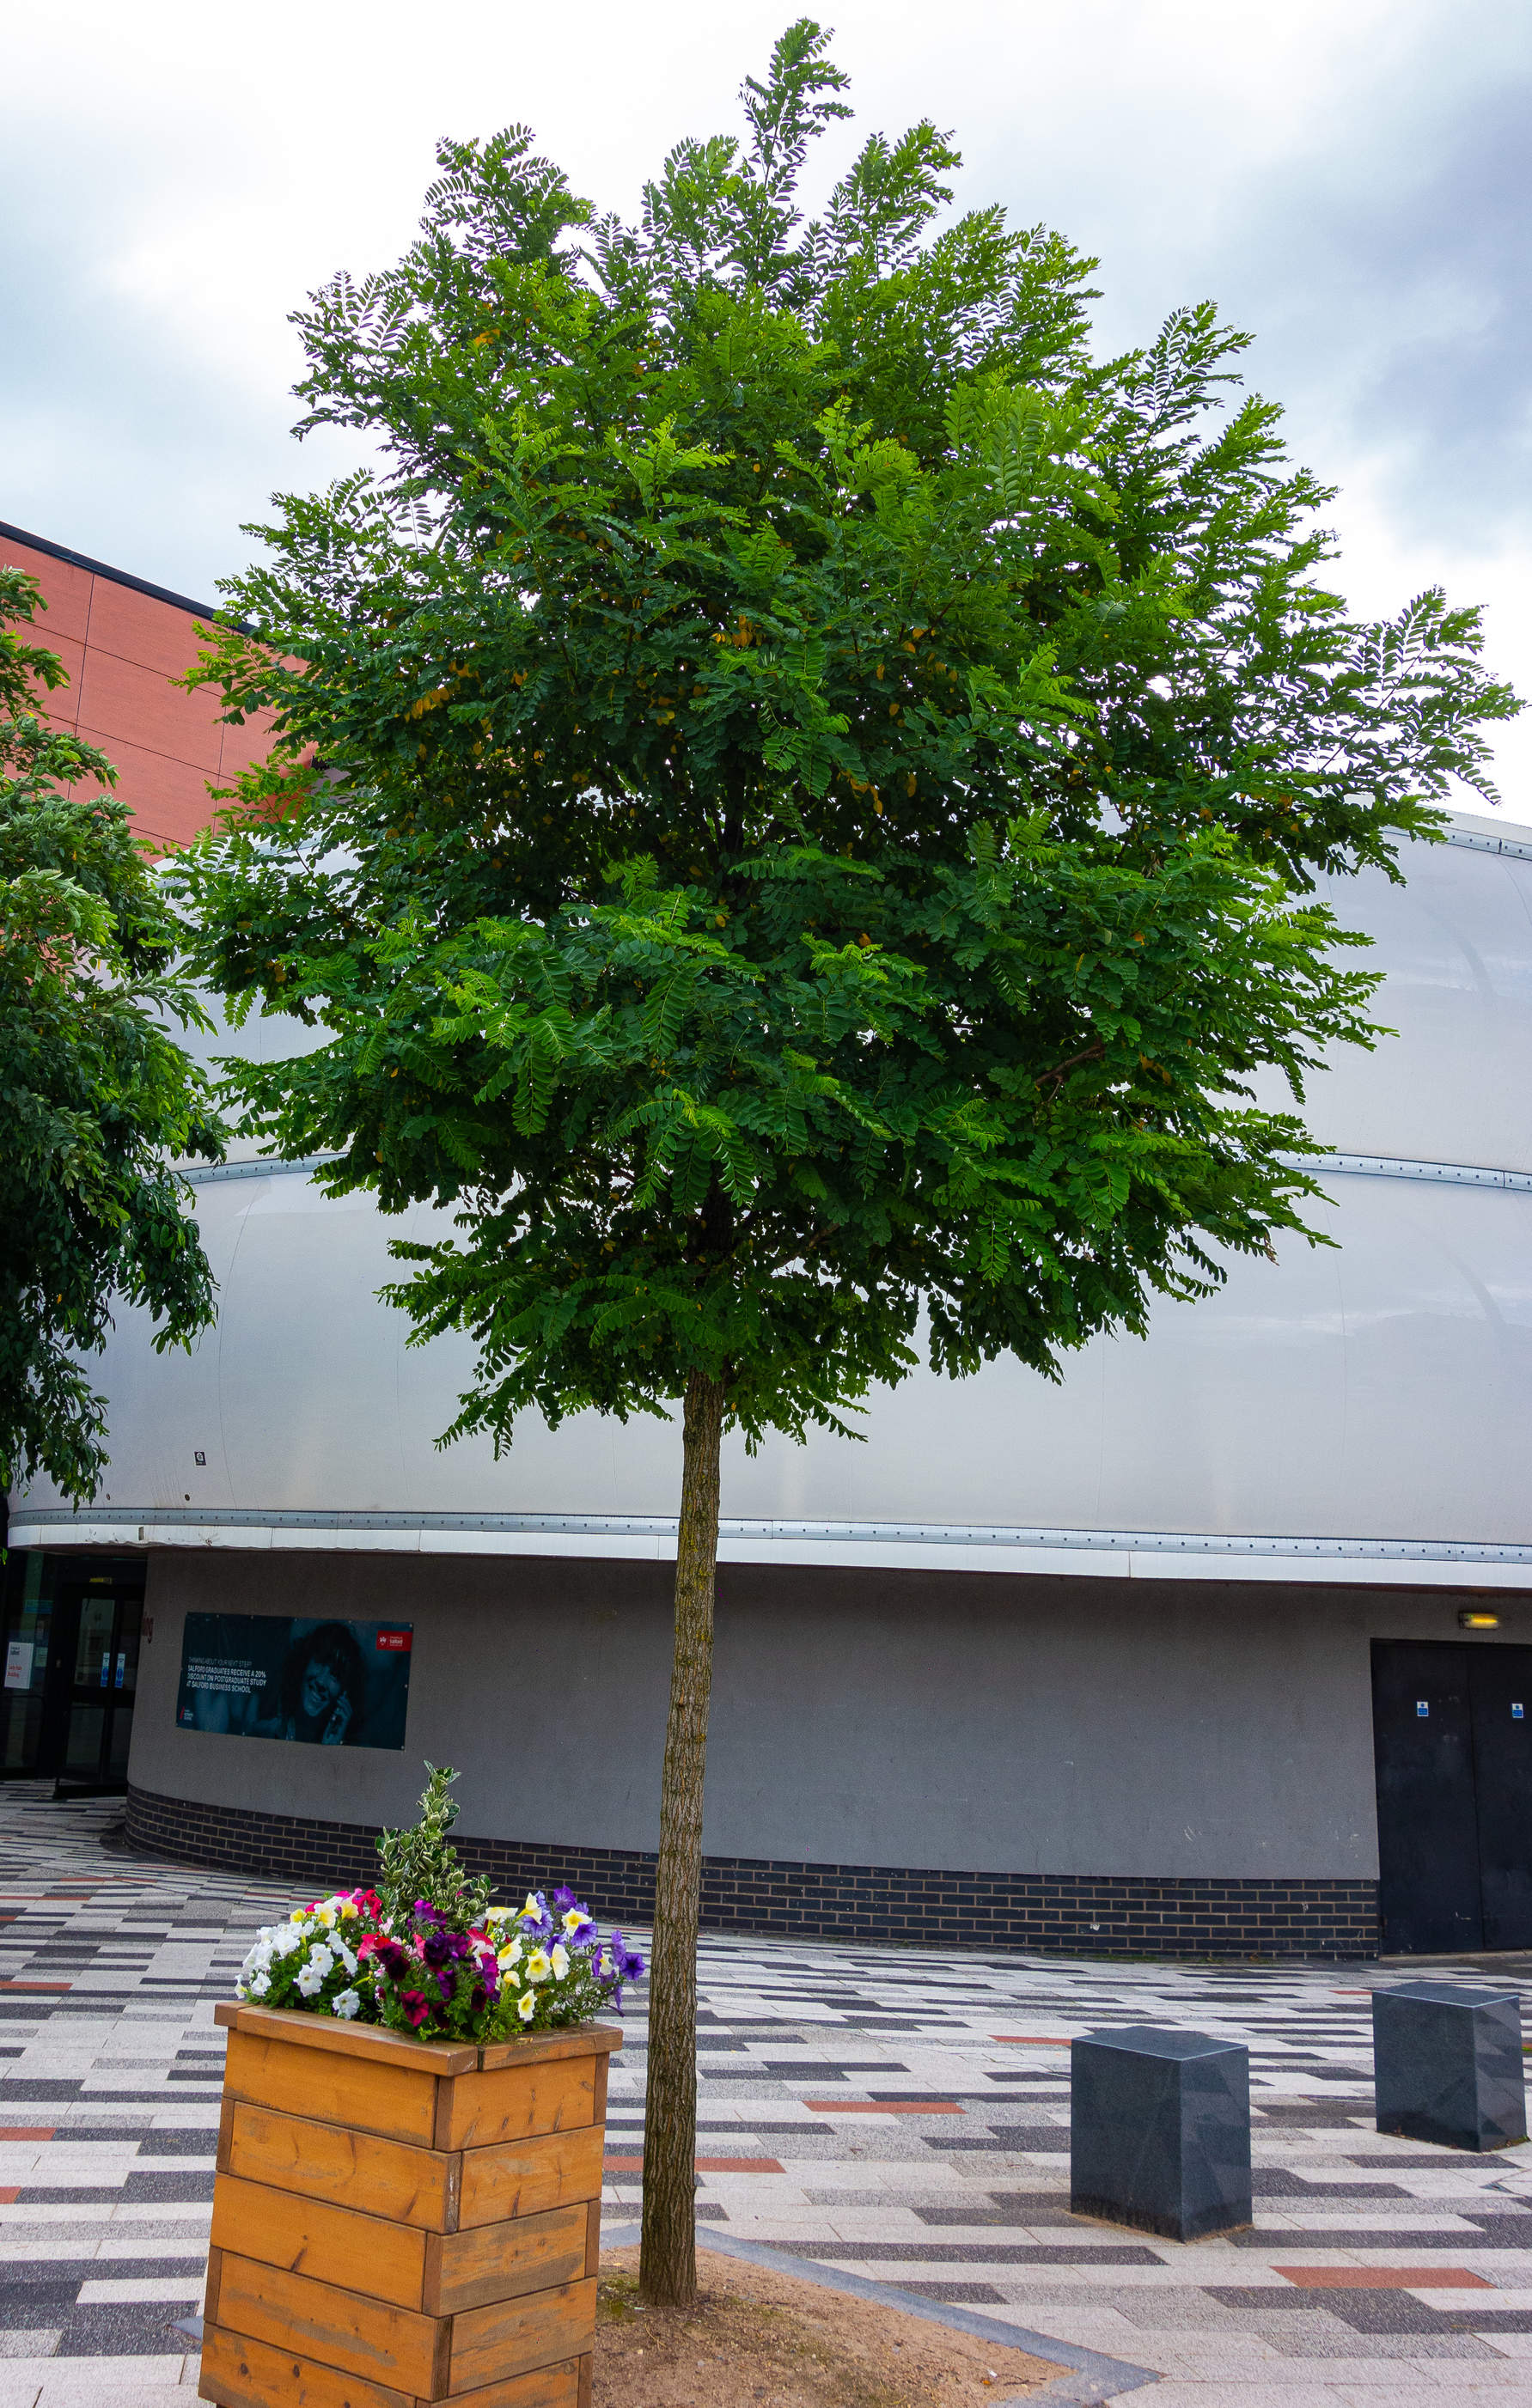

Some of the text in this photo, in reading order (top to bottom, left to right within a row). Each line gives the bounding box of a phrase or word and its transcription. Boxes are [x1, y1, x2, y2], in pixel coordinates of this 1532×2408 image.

[187, 1664, 206, 1673] SALFORD
[205, 1667, 230, 1675] GRADUATES
[230, 1668, 251, 1677] RECEIVE
[254, 1670, 266, 1679] 20%
[186, 1673, 207, 1681] DISCOUNT
[214, 1675, 249, 1686] POSTGRADUATE
[249, 1678, 267, 1687] STUDY
[191, 1680, 209, 1689] SALFORD
[209, 1683, 231, 1692] BUSINESS
[231, 1685, 252, 1693] SCHOOL
